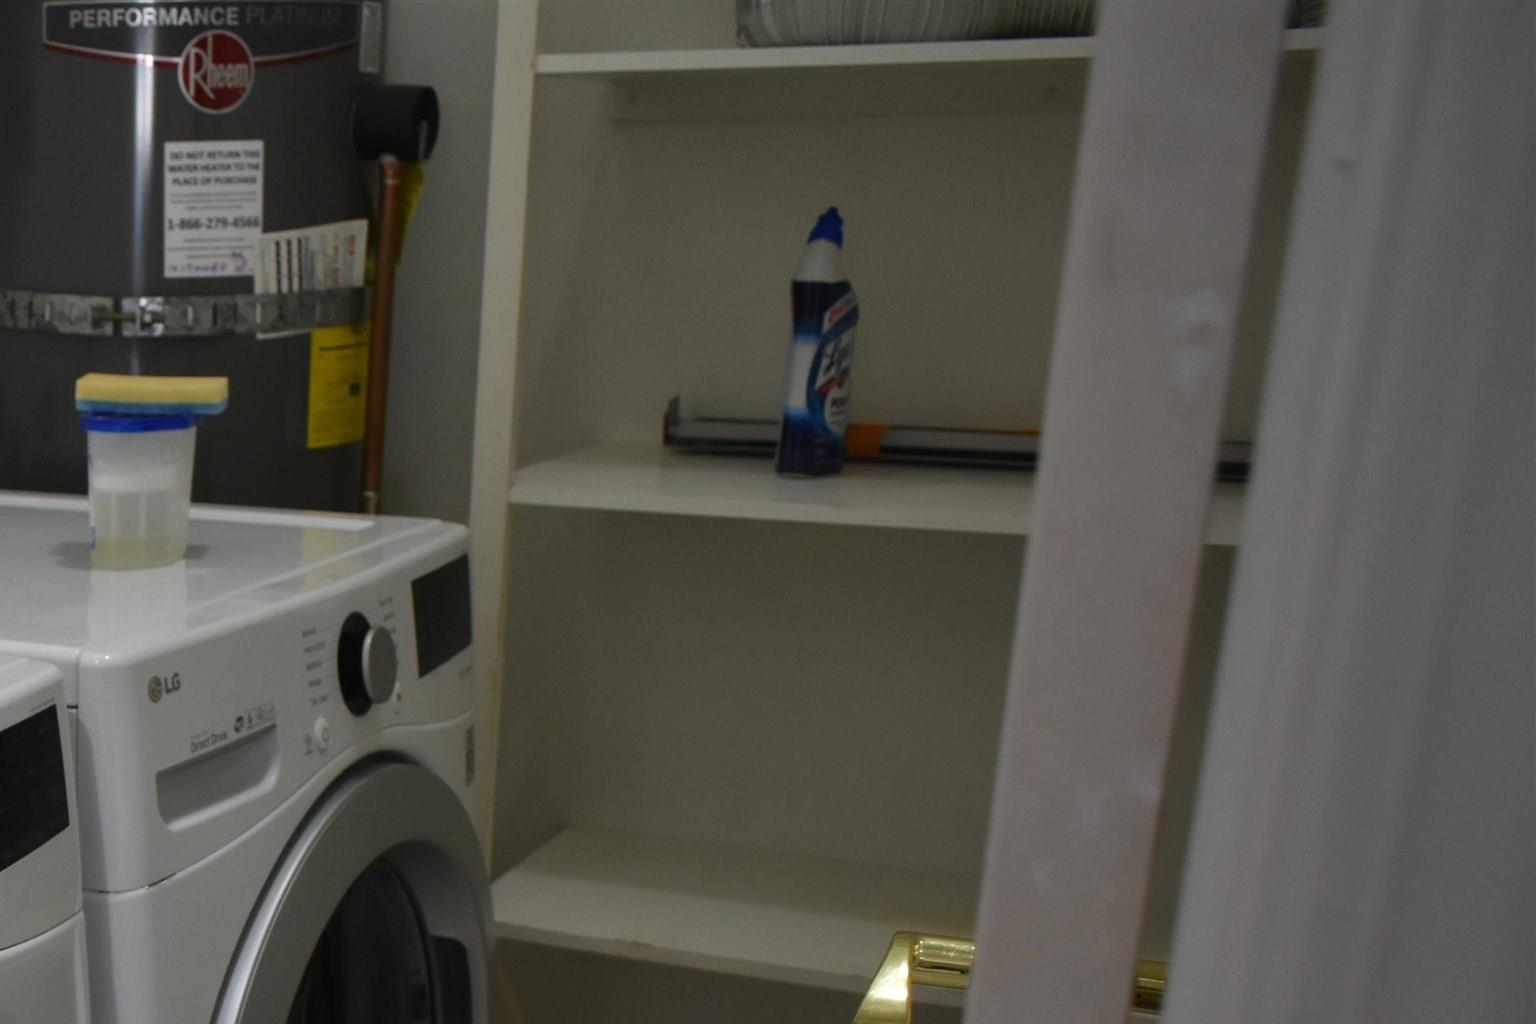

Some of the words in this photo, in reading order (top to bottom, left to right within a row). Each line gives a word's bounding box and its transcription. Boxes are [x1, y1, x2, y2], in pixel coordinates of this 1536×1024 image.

[69, 7, 239, 28] PERFORMANCE
[188, 33, 249, 100] Rheem
[186, 151, 204, 159] NOT
[207, 150, 241, 159] RETURN
[168, 164, 198, 172] WATER
[200, 163, 231, 171] HEATER
[172, 177, 198, 185] PLACE
[164, 672, 182, 694] LG
